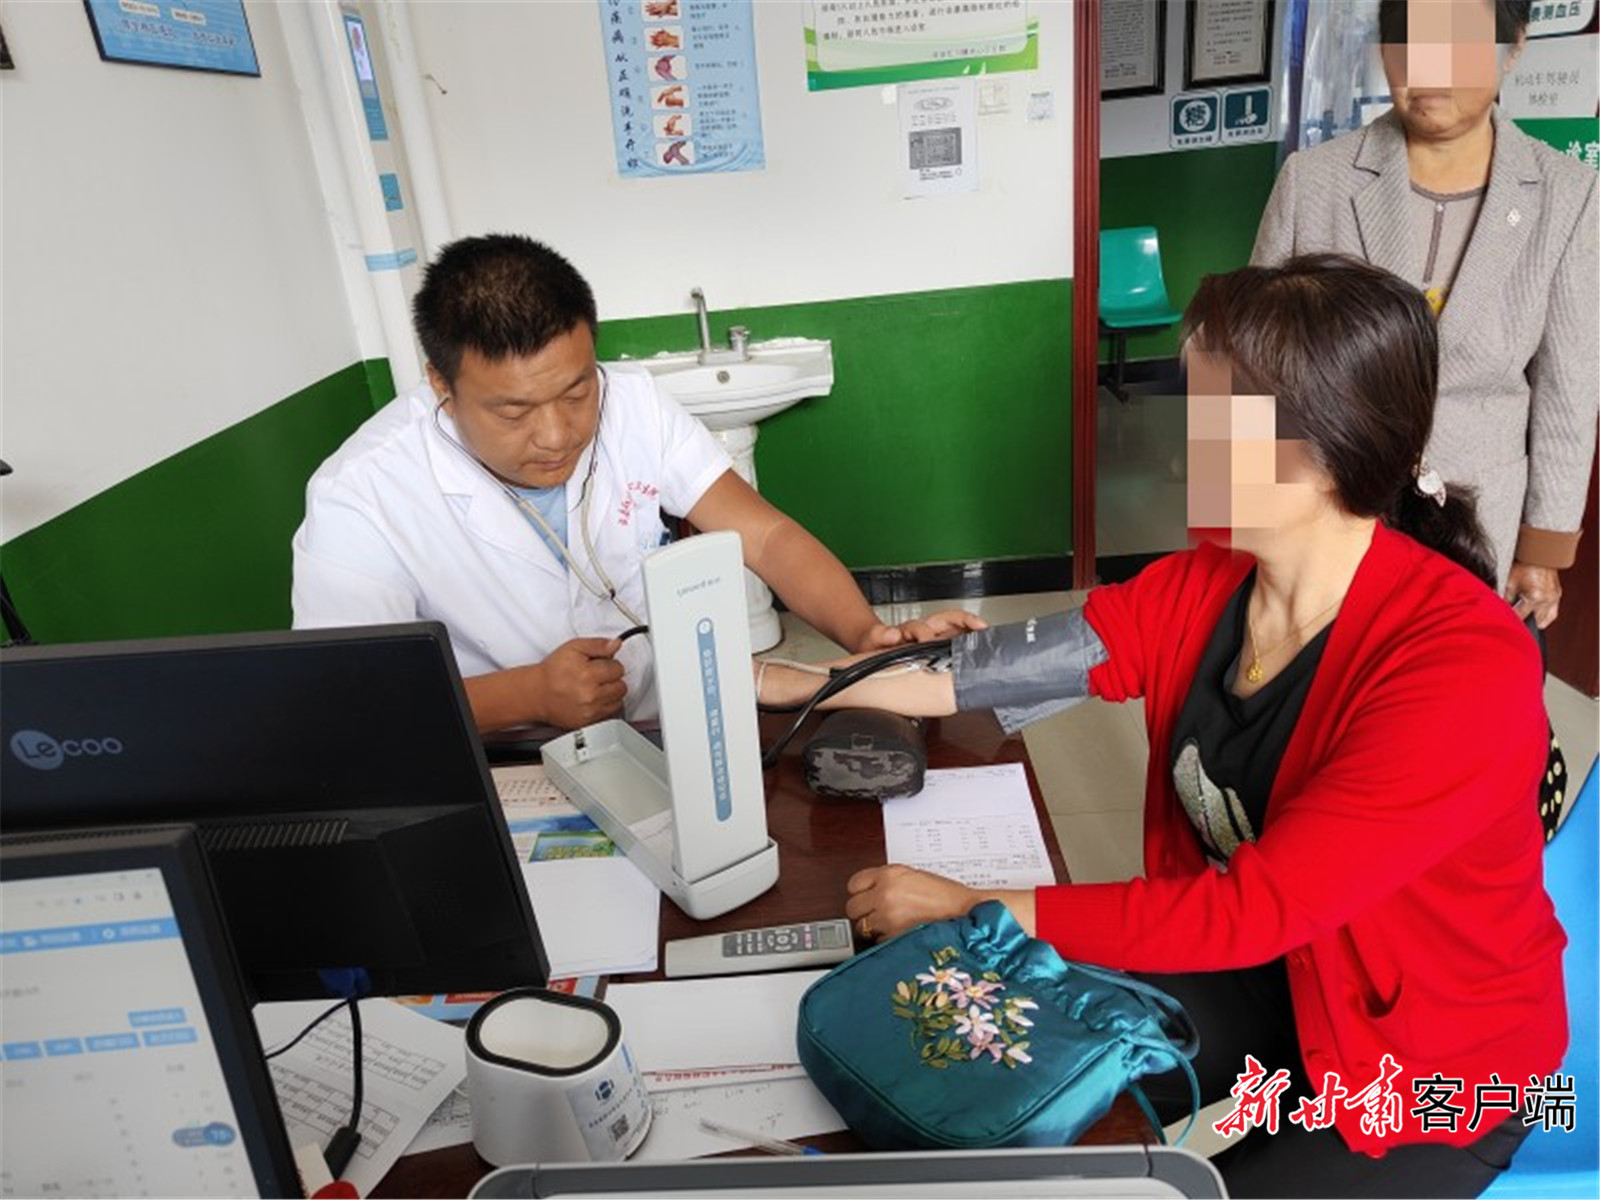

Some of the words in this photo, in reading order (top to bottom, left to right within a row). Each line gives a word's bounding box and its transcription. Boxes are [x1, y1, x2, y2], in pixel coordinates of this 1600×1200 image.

[1514, 69, 1580, 87] 机动车驾驶员
